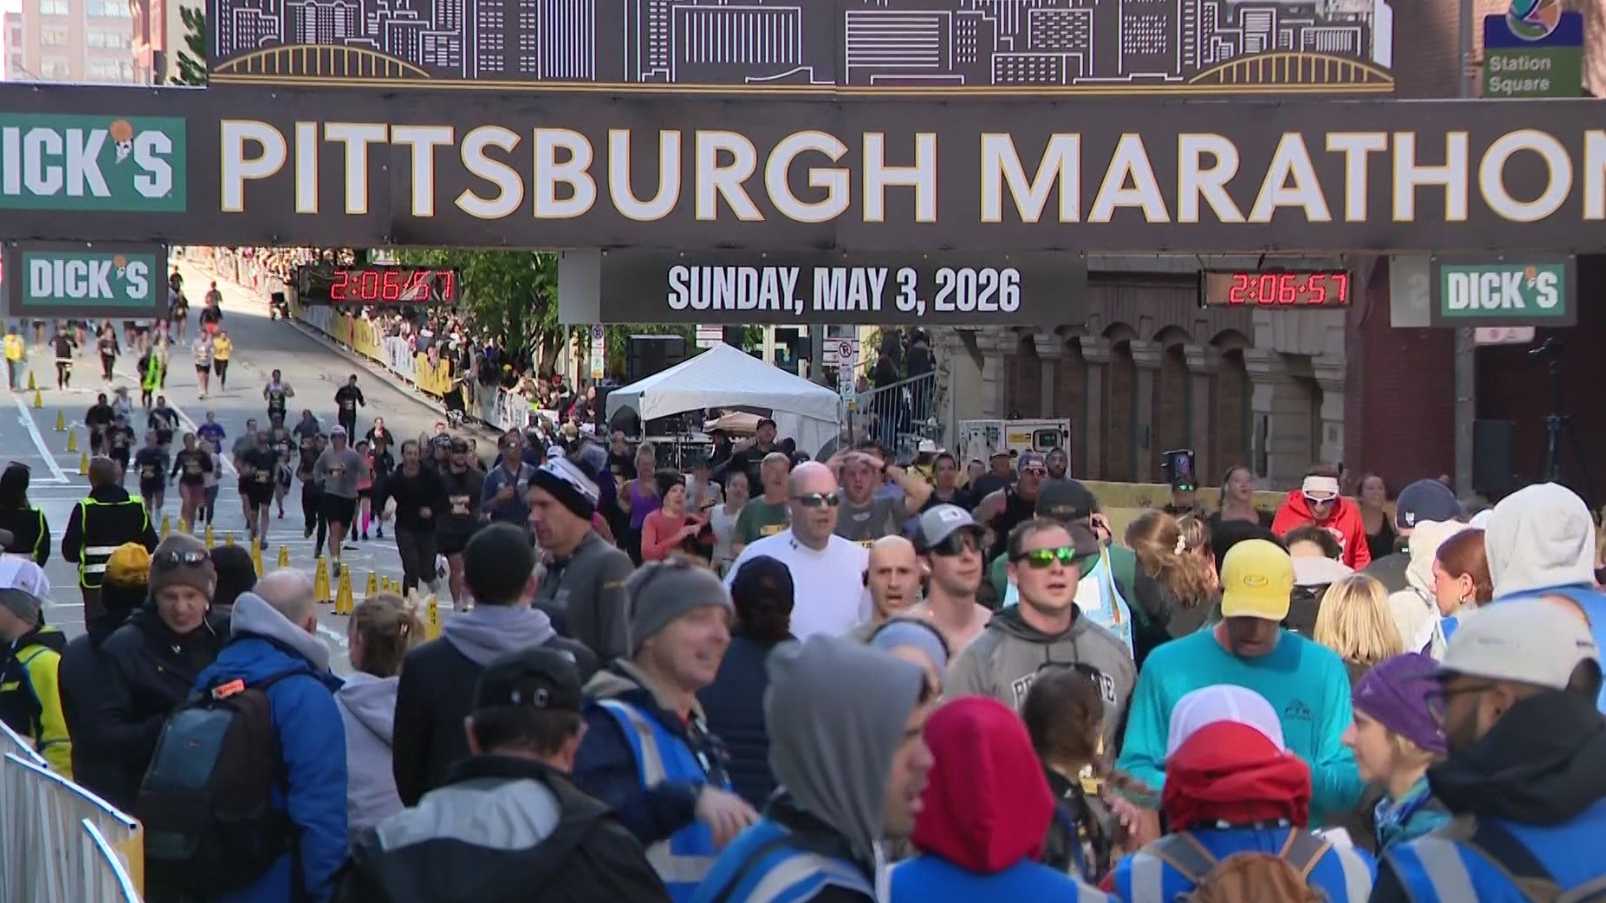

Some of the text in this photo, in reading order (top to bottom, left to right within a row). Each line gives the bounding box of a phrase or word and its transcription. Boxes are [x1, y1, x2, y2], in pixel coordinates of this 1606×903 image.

[1489, 56, 1552, 72] Station
[1489, 76, 1551, 95] Square
[2, 119, 173, 198] ICK'S
[220, 119, 937, 223] PITTSBURGH
[30, 255, 149, 299] DICK'S
[667, 265, 1021, 316] SUNDAY, MAY 3, 2026
[1447, 265, 1559, 310] DICK'S
